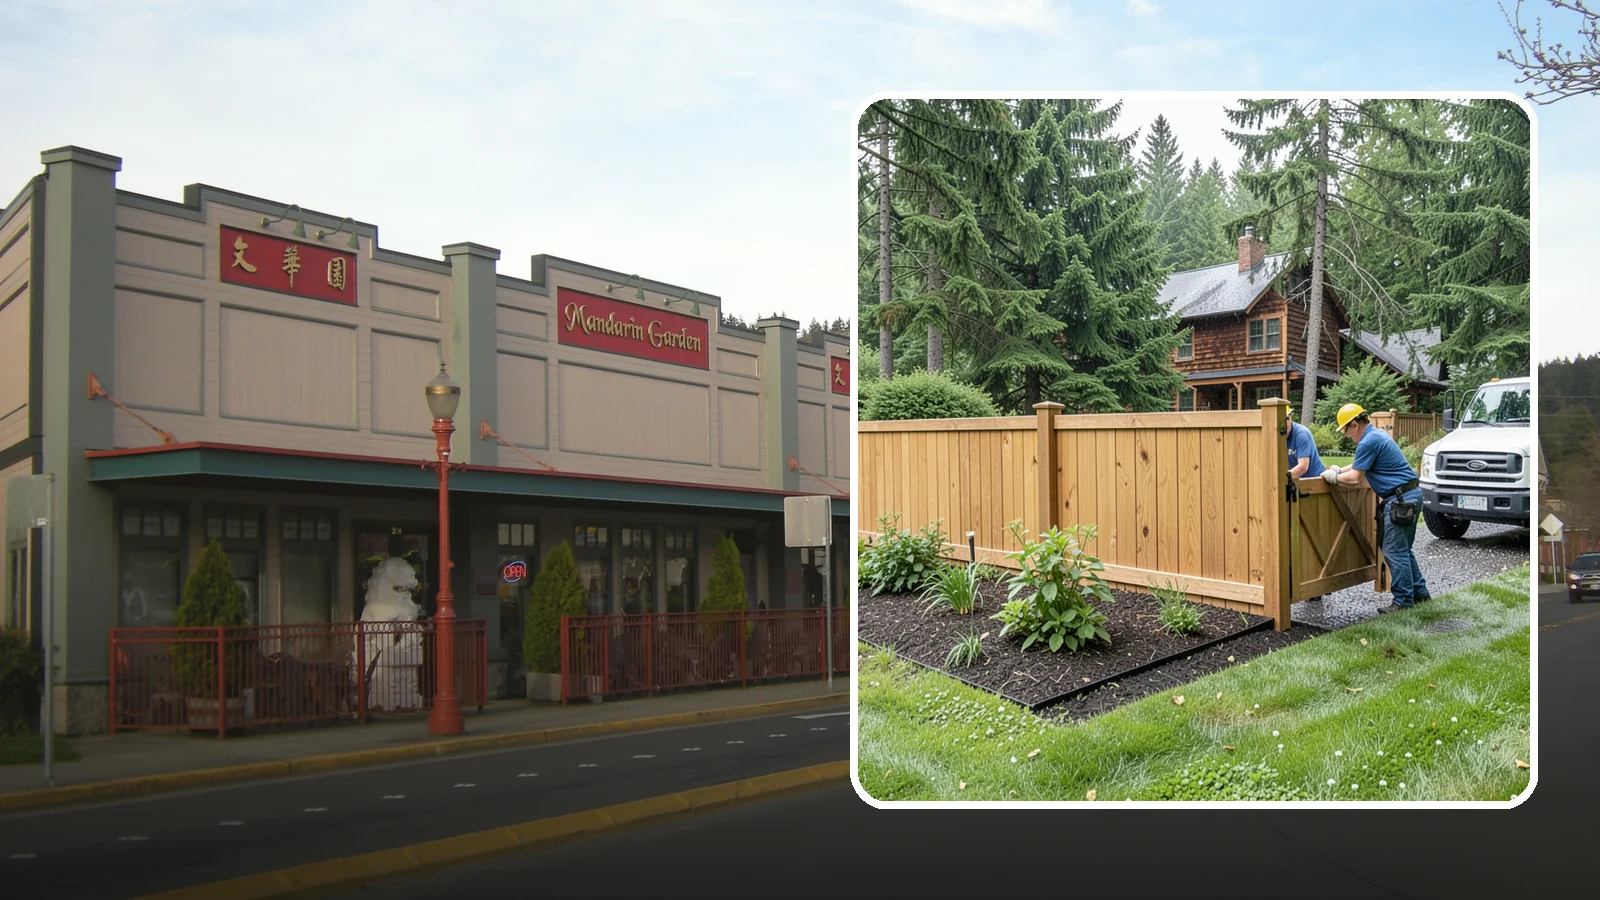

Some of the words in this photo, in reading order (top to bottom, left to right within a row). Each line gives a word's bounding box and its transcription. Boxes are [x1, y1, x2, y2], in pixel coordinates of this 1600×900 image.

[231, 236, 346, 291] 文華園
[564, 302, 644, 341] Mandarin
[648, 320, 701, 352] Garden
[503, 565, 527, 578] OPEN
